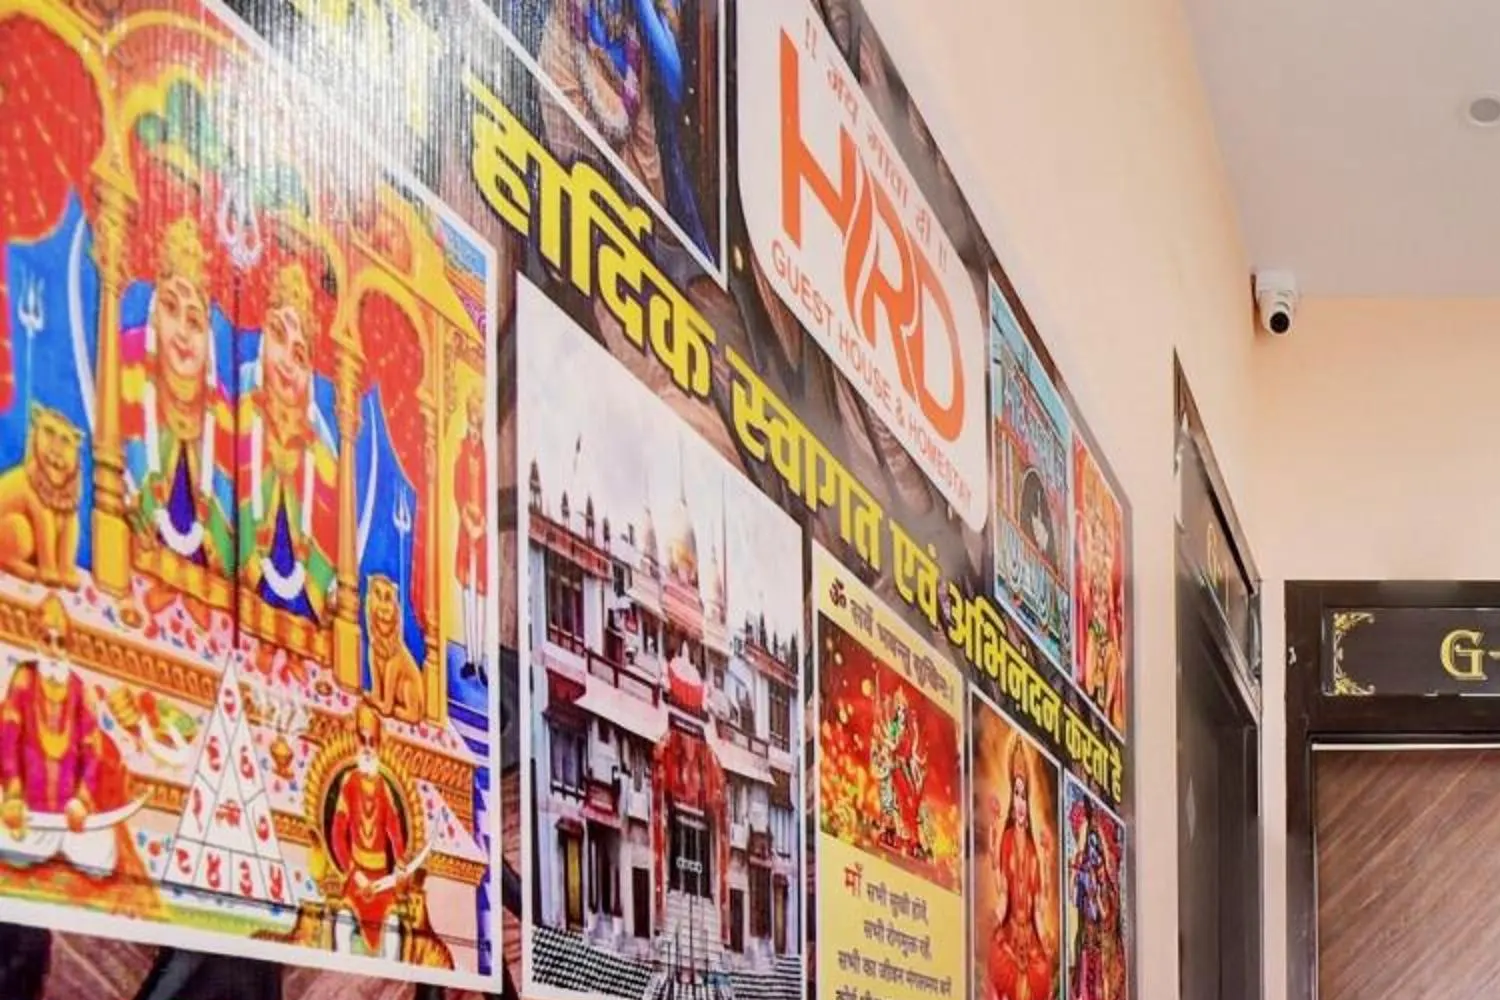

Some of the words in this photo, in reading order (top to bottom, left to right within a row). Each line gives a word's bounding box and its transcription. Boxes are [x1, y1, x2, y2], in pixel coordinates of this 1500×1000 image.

[867, 128, 908, 209] माता
[780, 25, 965, 442] HRD
[772, 240, 835, 337] GUEST
[839, 323, 892, 410] HOUSE
[896, 397, 906, 428] &
[463, 66, 716, 397] हार्दिक
[726, 345, 882, 572] स्वागत
[889, 518, 940, 630] एवं
[949, 582, 1061, 744] अभिनंदन
[1063, 705, 1108, 793] करता
[1109, 740, 1123, 803] है
[830, 577, 847, 608] ॐ
[866, 881, 887, 907] सभी
[863, 917, 885, 943] सभी
[837, 947, 861, 974] सभी
[862, 956, 877, 979] का
